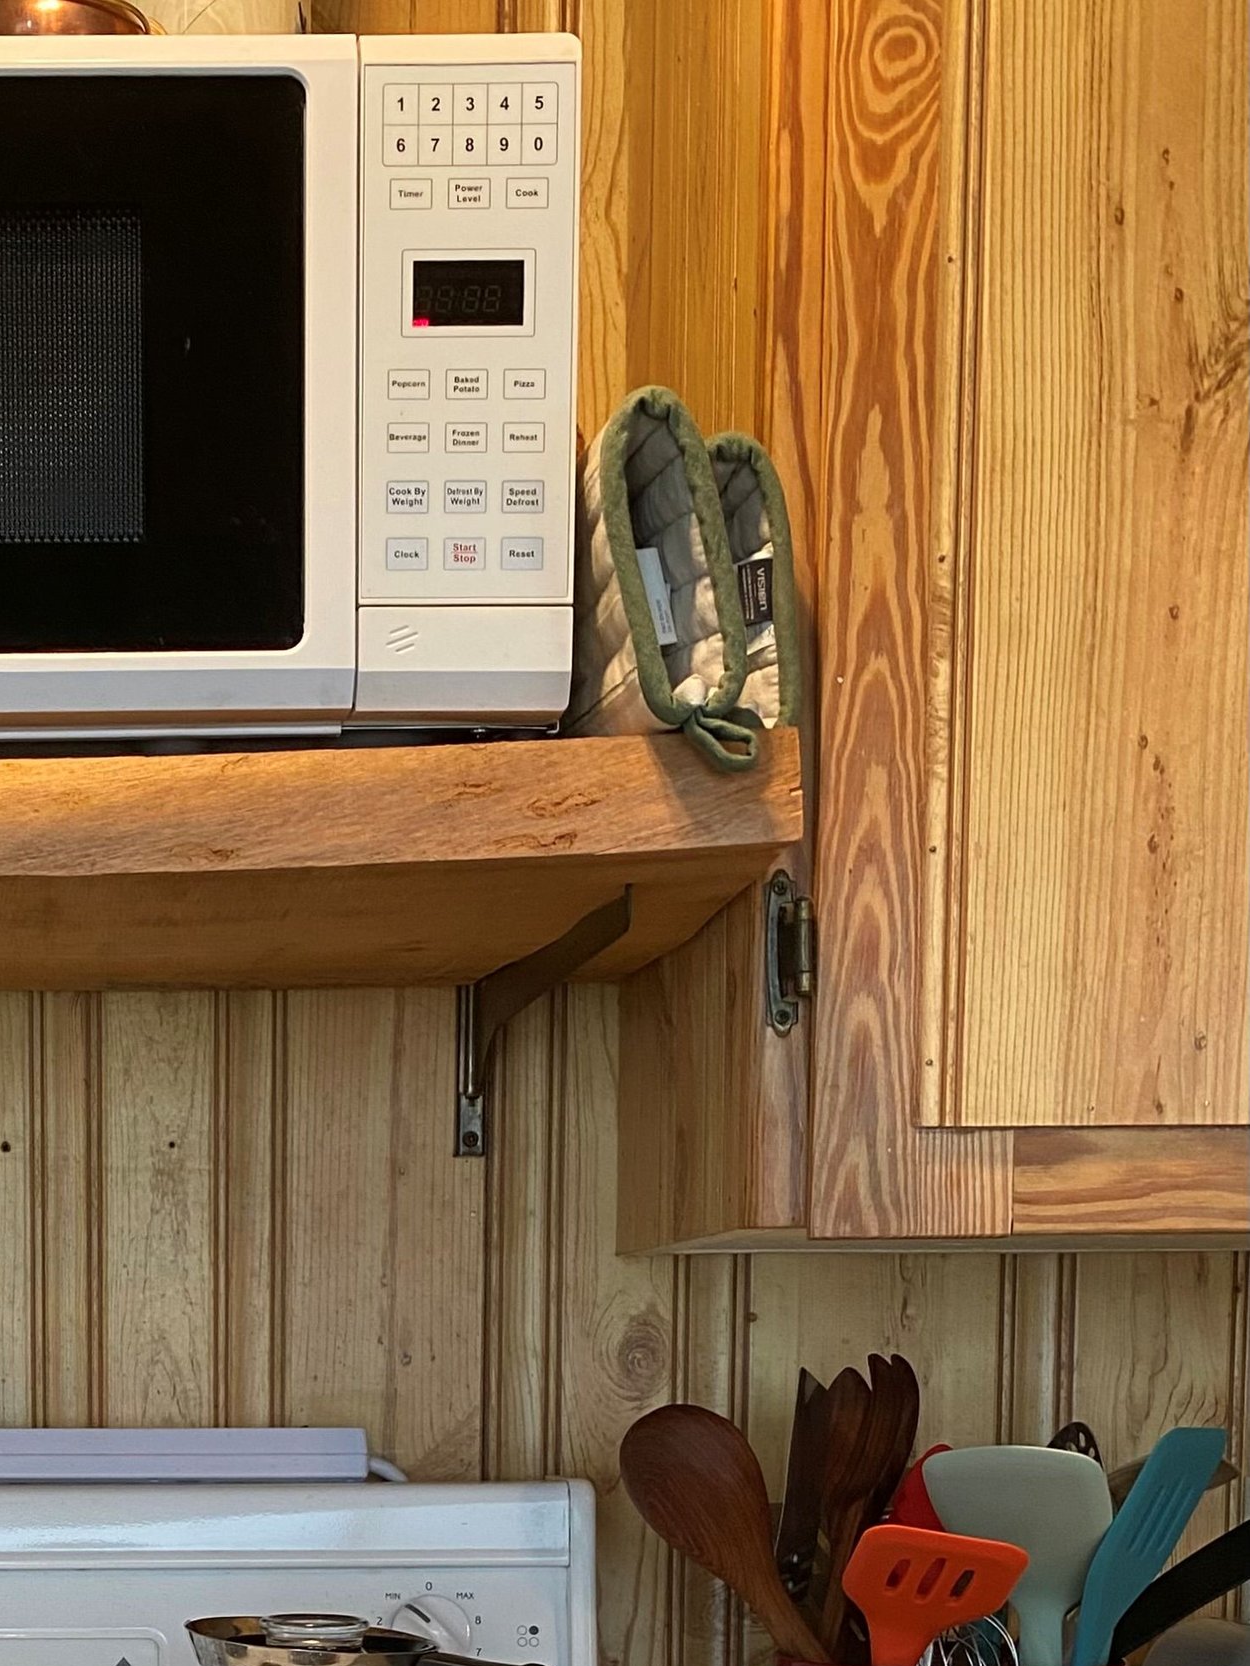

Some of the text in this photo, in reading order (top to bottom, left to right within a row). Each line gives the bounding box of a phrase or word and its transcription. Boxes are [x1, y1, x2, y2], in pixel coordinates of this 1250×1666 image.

[397, 96, 543, 111] 1 2 3 4 5
[396, 137, 543, 152] 6 7 8 9 0
[454, 184, 483, 192] Power
[398, 190, 423, 198] Timer
[515, 189, 538, 197] Cook
[456, 195, 481, 203] Level
[391, 380, 426, 388] Popcorn
[454, 376, 480, 384] Baked
[513, 380, 535, 388] Pizza
[453, 385, 480, 393] Potato
[452, 429, 480, 437] Frozen
[389, 433, 427, 442] Beverage
[389, 487, 426, 497] Cook By
[447, 487, 484, 497] Defrost By
[509, 488, 537, 497] Speed
[392, 498, 423, 507] Weight
[450, 497, 480, 507] Weight
[506, 498, 539, 506] Defrost
[453, 543, 477, 551] Start
[394, 550, 420, 559] Clock
[509, 550, 535, 558] Reset
[453, 554, 476, 563] Stop
[385, 1592, 401, 1600] MIN
[456, 1592, 474, 1600] MAX
